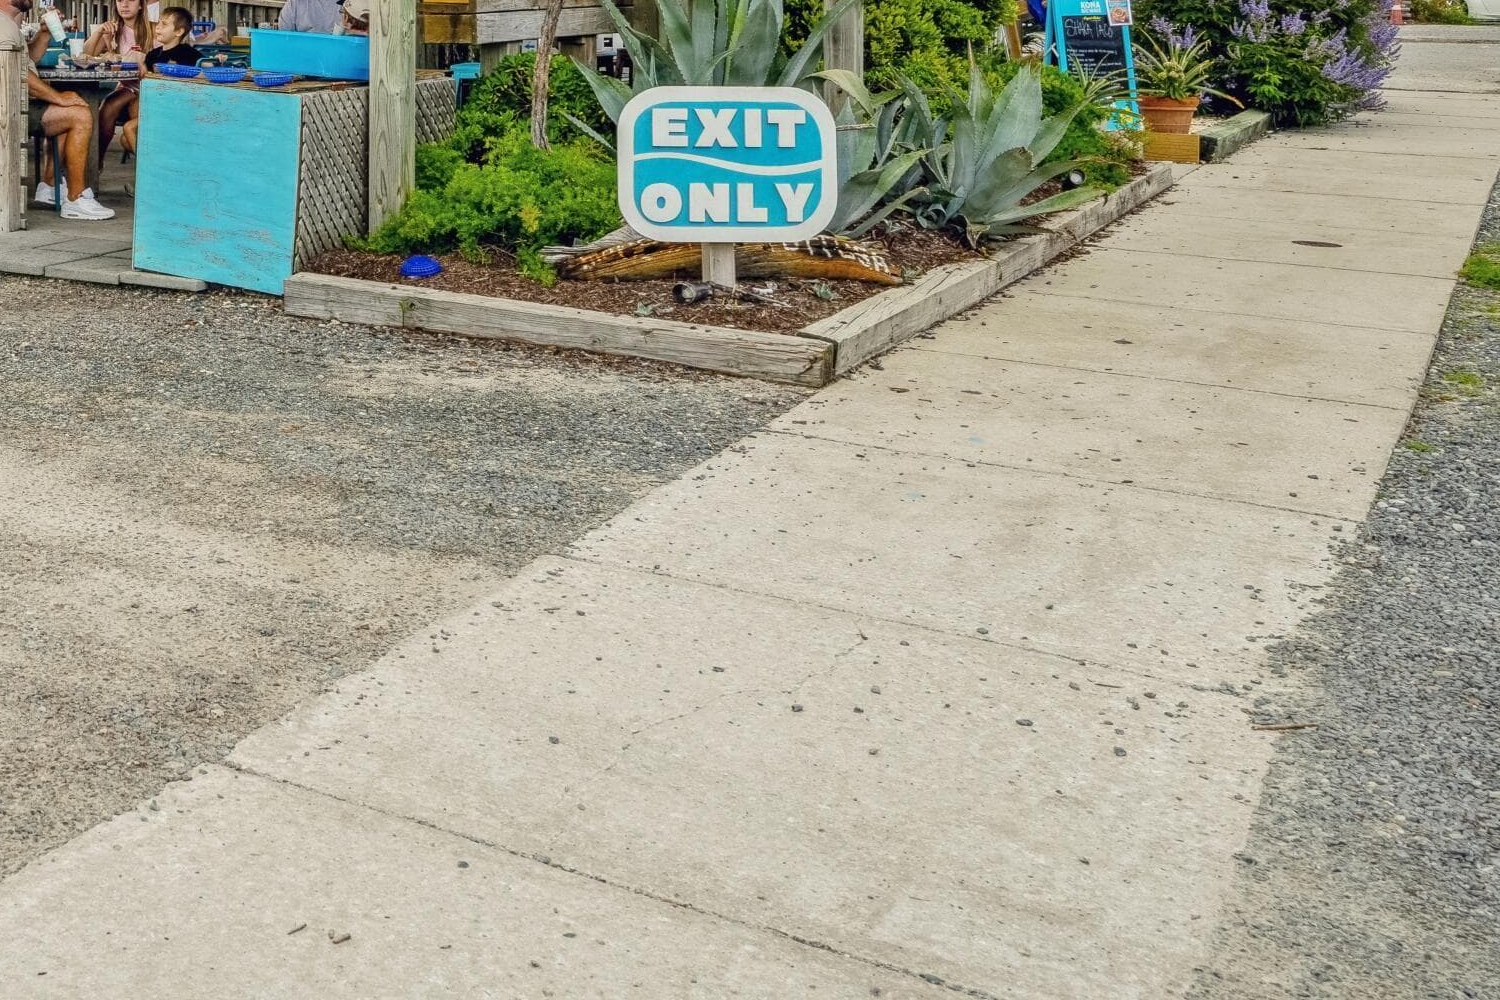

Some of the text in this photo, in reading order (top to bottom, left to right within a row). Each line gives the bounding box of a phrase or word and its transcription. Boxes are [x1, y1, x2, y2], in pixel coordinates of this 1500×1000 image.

[1080, 1, 1101, 10] KONA
[651, 108, 807, 149] EXIT
[640, 182, 815, 223] ONLY
